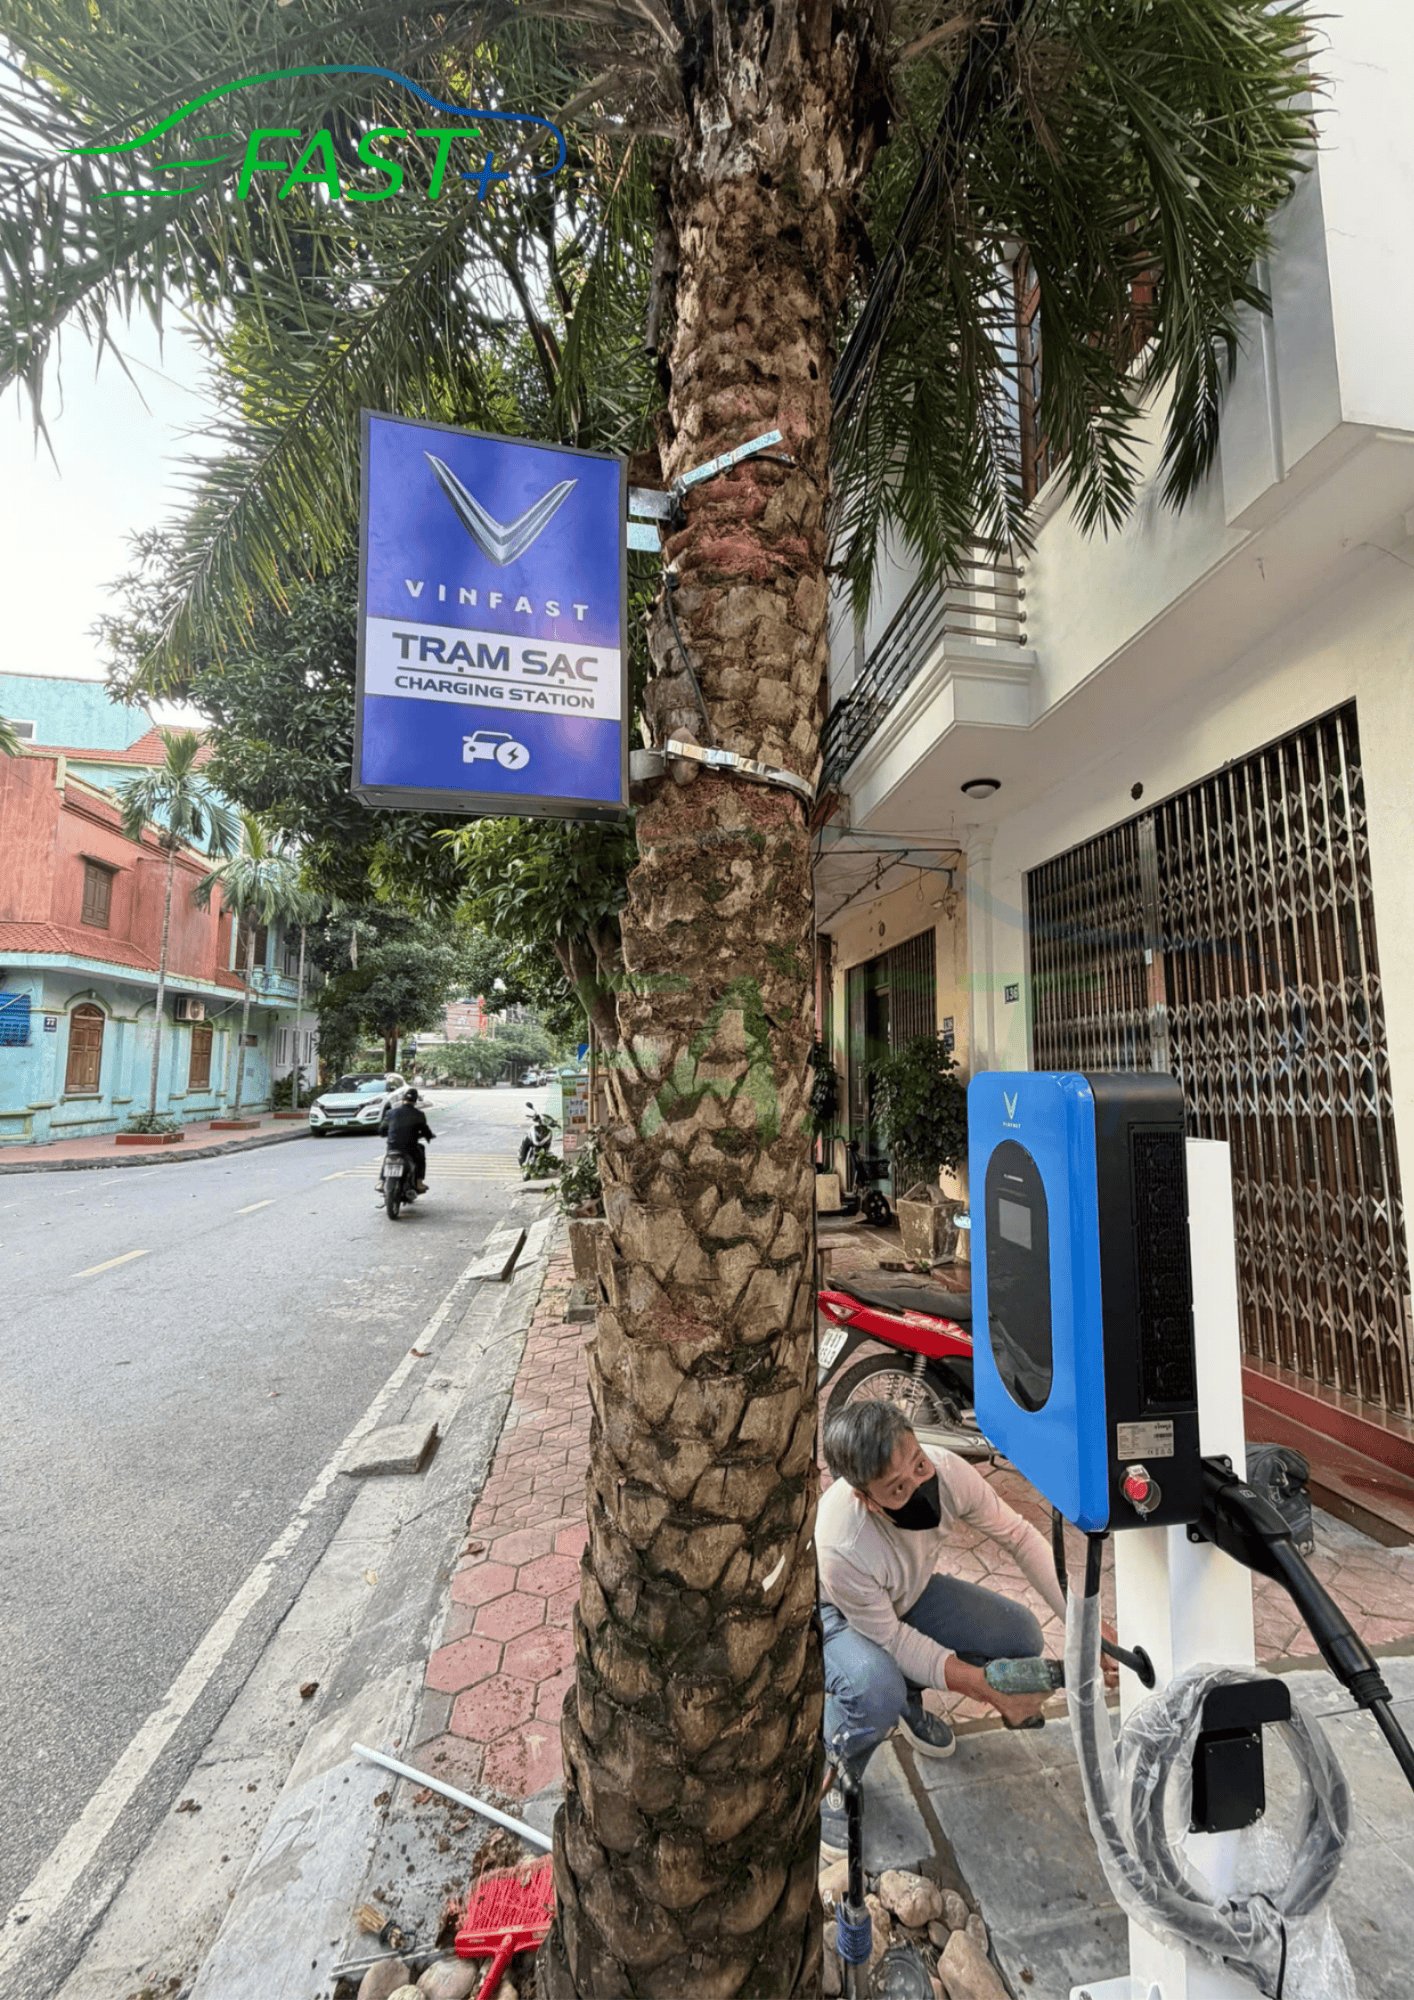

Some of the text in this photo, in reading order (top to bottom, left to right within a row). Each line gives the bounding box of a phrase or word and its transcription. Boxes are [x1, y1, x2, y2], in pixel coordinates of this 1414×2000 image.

[405, 579, 589, 621] VINFAST
[392, 631, 599, 685] TRẠM SẠC
[394, 675, 595, 709] CHARGING STATION
[1005, 986, 1019, 1001] 136
